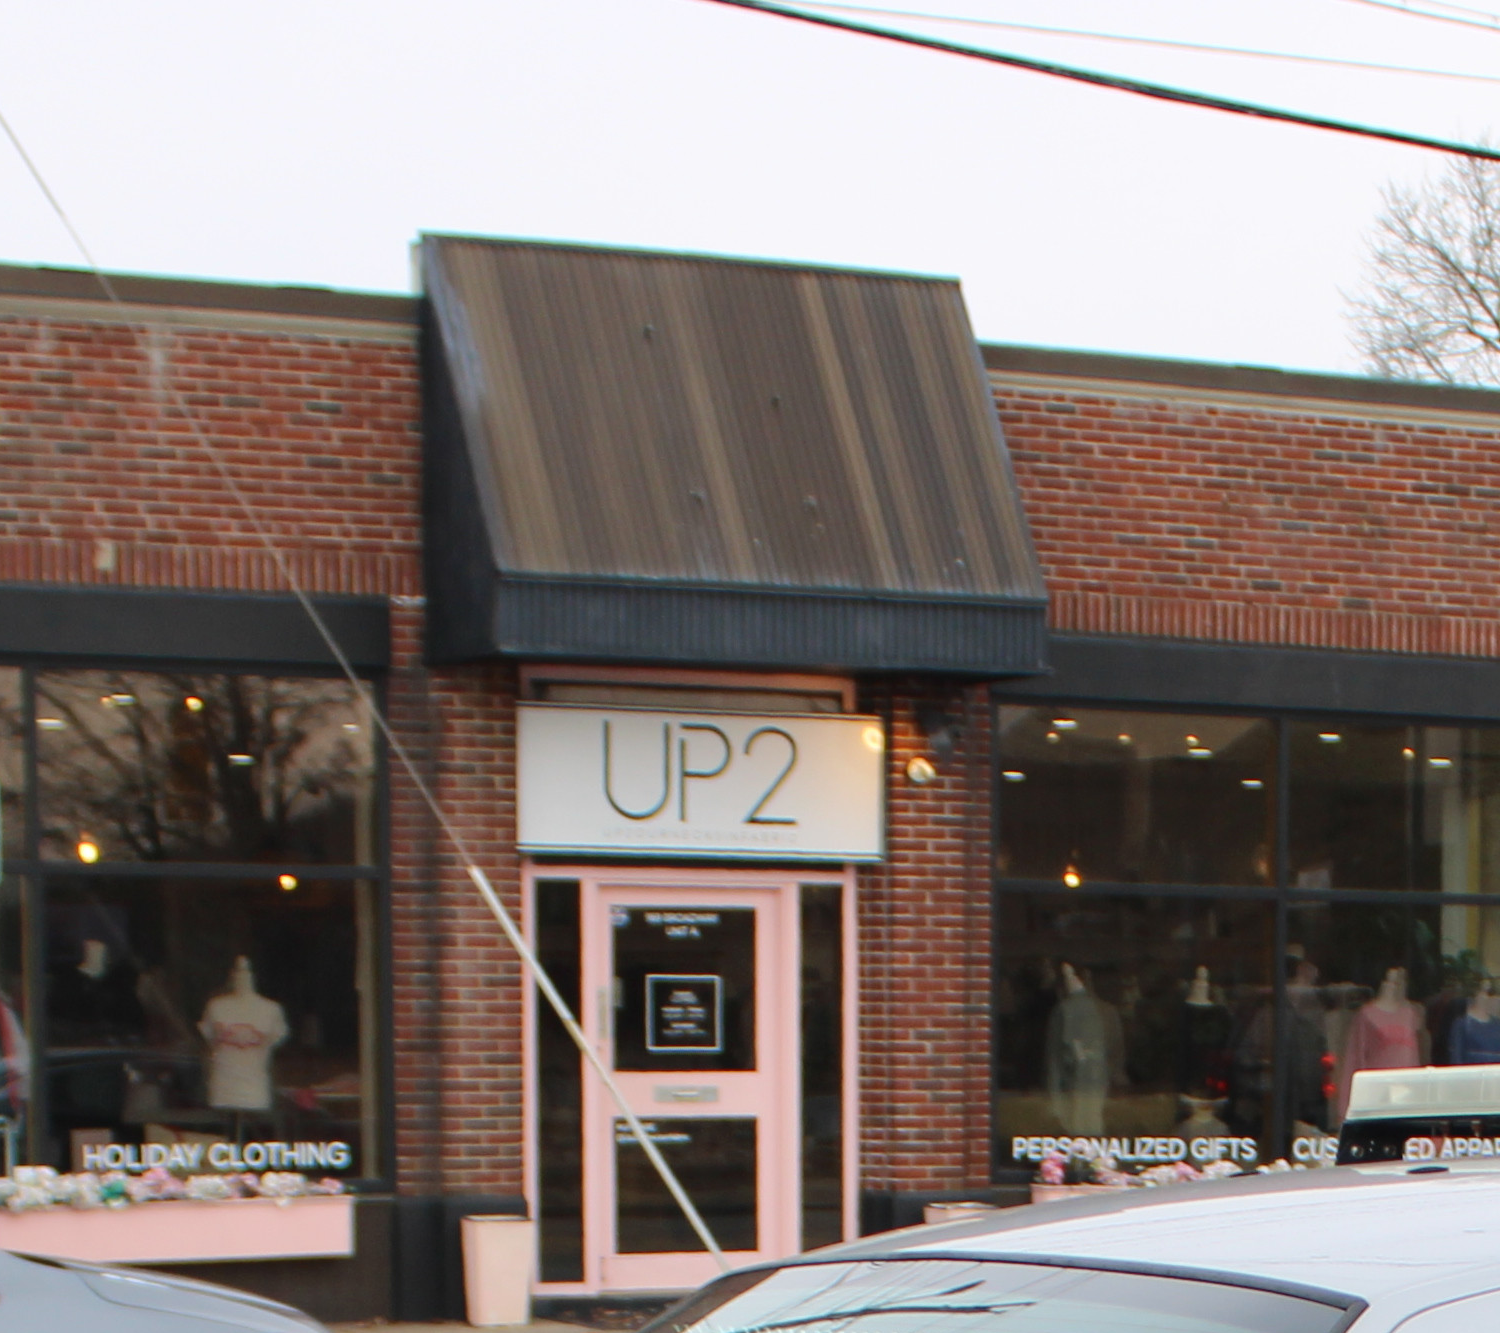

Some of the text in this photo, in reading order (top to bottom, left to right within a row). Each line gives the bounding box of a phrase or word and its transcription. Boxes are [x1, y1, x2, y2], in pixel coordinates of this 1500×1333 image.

[82, 1142, 352, 1170] HOLIDAY CLOTHING
[1012, 1136, 1258, 1162] PERSONALIZED GIFTS
